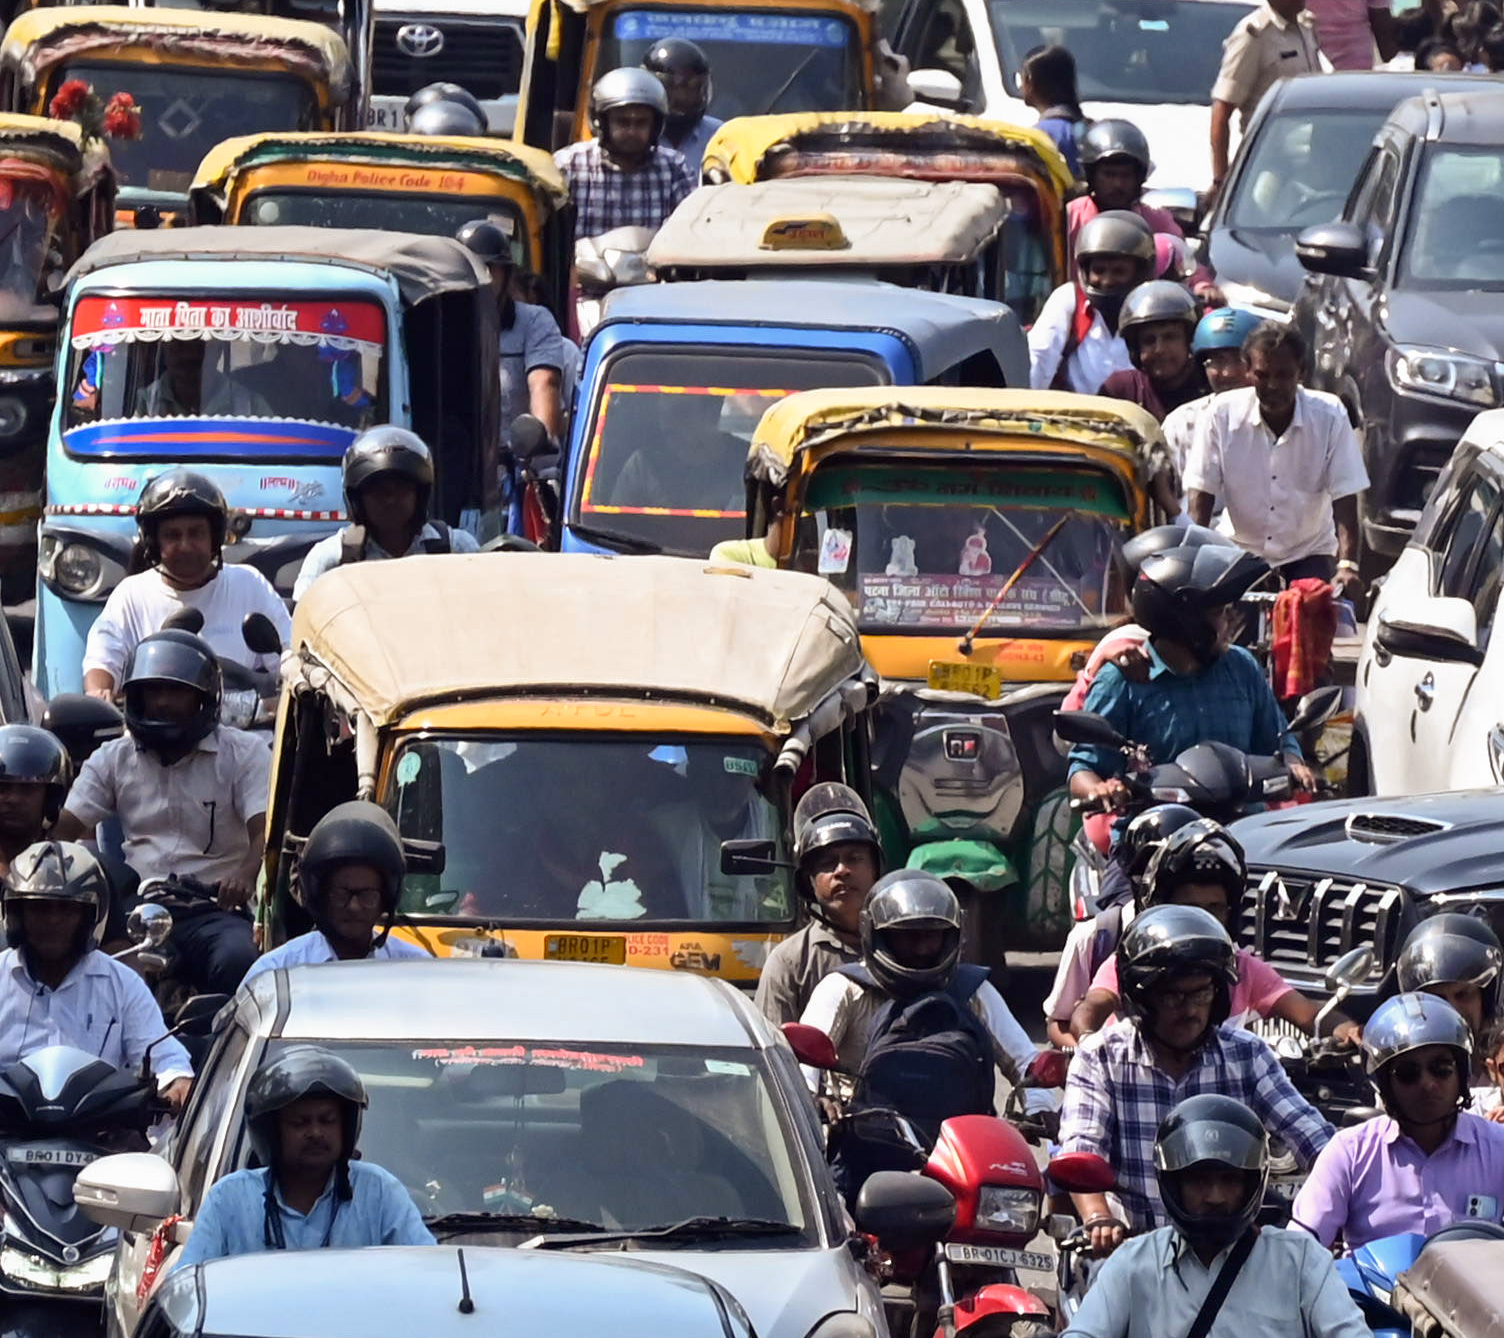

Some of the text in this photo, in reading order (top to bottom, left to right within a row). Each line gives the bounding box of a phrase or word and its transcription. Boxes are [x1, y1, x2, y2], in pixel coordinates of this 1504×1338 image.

[352, 171, 396, 186] Police
[399, 173, 432, 188] Code
[139, 302, 298, 331] माता पिता का आशीर्वाद
[557, 936, 611, 956] BR01P
